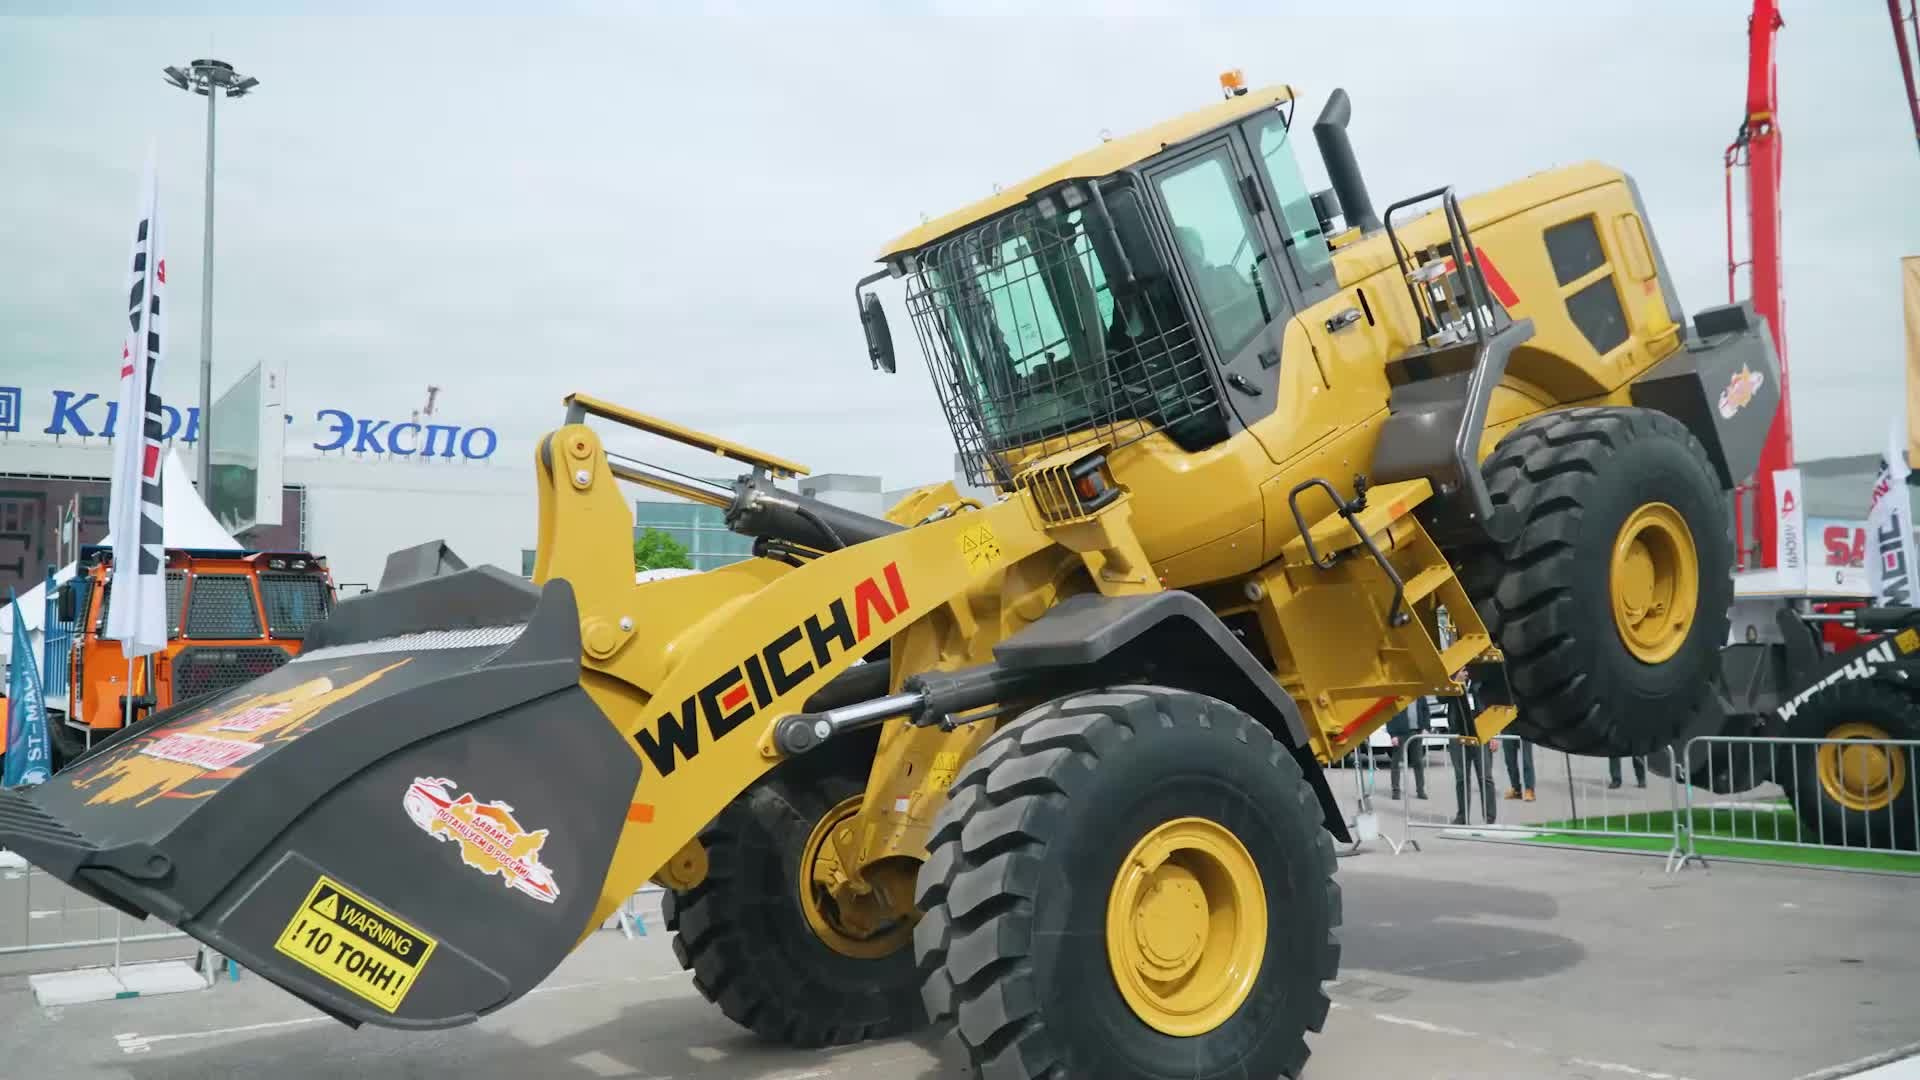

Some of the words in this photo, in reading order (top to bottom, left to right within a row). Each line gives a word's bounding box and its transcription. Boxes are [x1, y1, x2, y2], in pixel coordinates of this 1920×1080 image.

[634, 561, 910, 777] WEICHAI
[436, 808, 487, 849] ПОТАНЦУЕМ
[472, 816, 514, 848] ДАВАЙТЕ
[340, 904, 413, 956] WARNING
